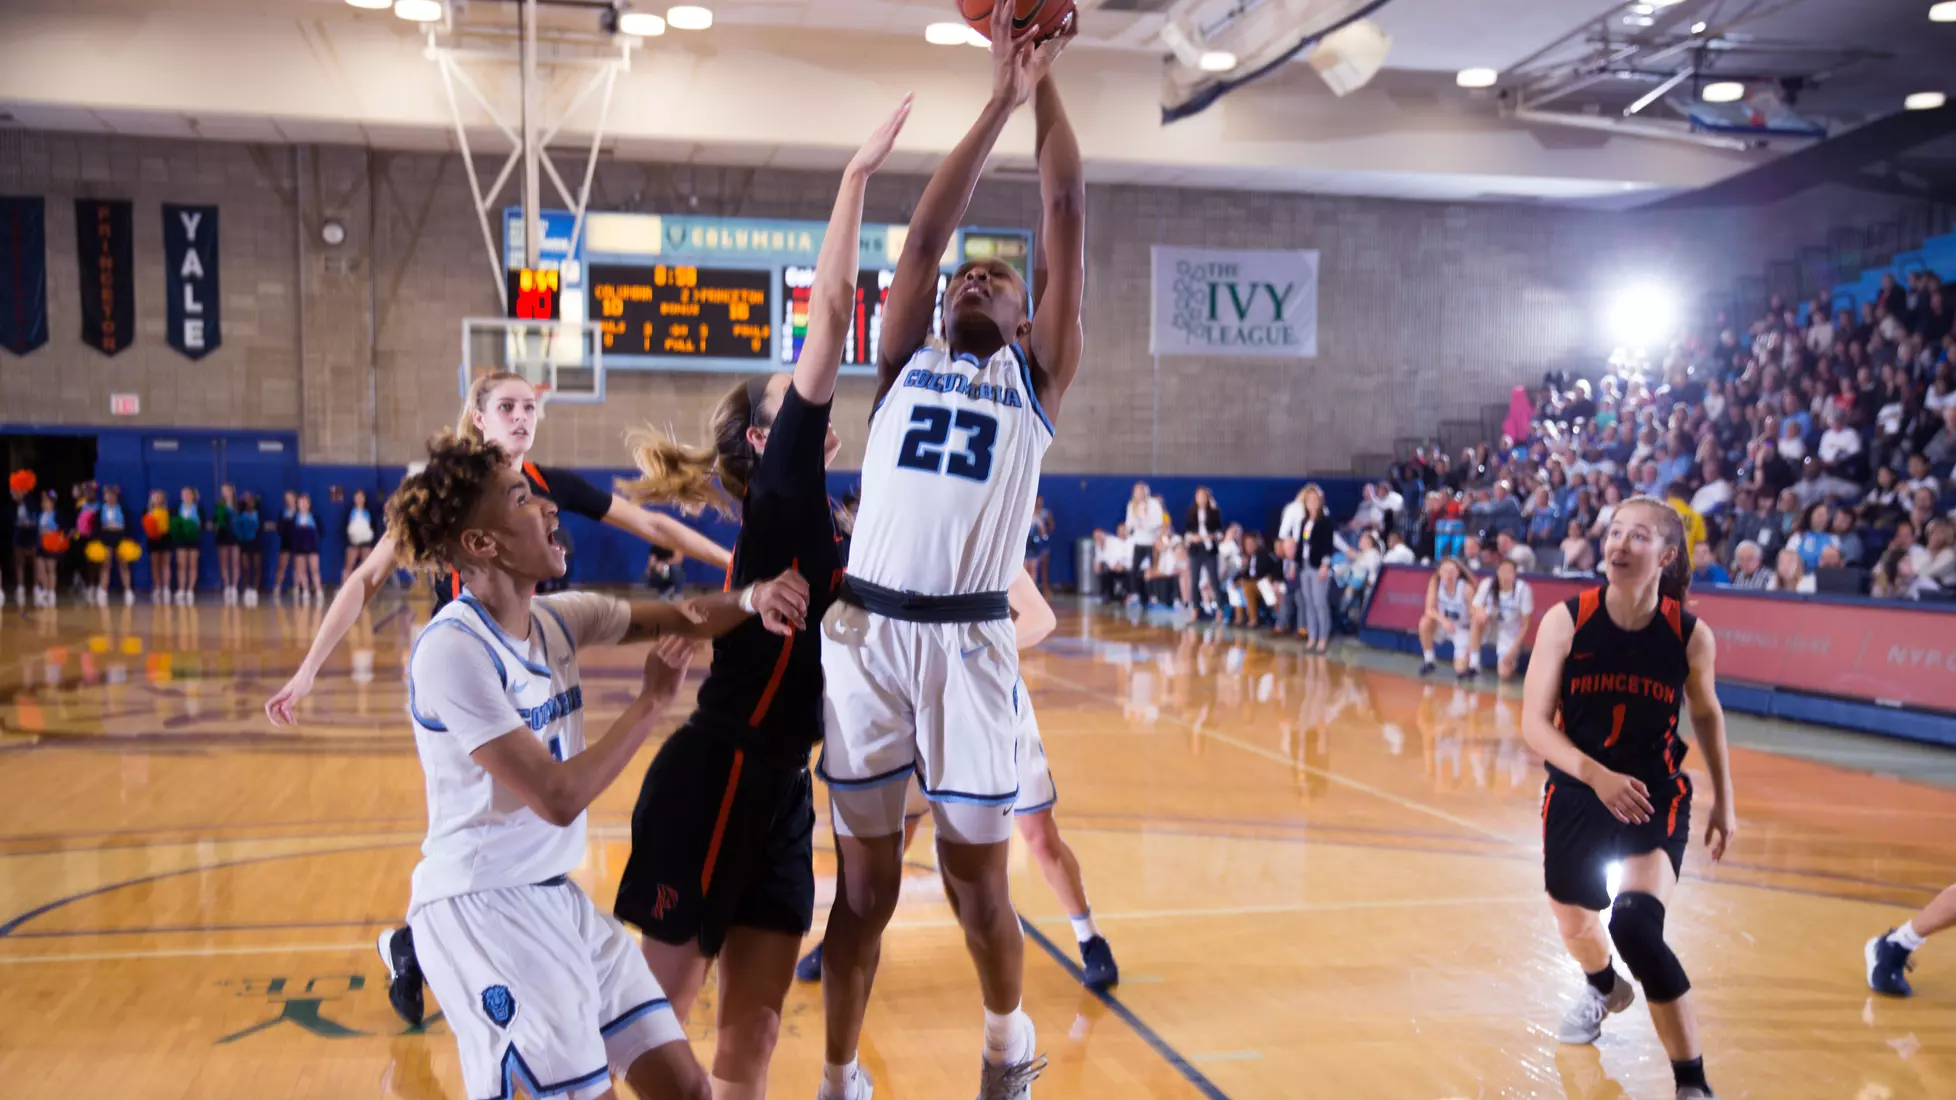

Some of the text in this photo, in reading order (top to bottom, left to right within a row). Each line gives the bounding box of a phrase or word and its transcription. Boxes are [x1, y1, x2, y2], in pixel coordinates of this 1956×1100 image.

[690, 226, 812, 250] COLUMBIA
[180, 211, 205, 348] YALE
[1208, 263, 1239, 277] THE
[1207, 281, 1294, 322] IVY
[1206, 325, 1298, 345] LEAGUE
[903, 369, 1023, 408] COLUMBIA
[896, 403, 998, 484] 23
[1570, 672, 1675, 704] PRINCETON
[1603, 703, 1626, 748] 1
[651, 883, 679, 920] P
